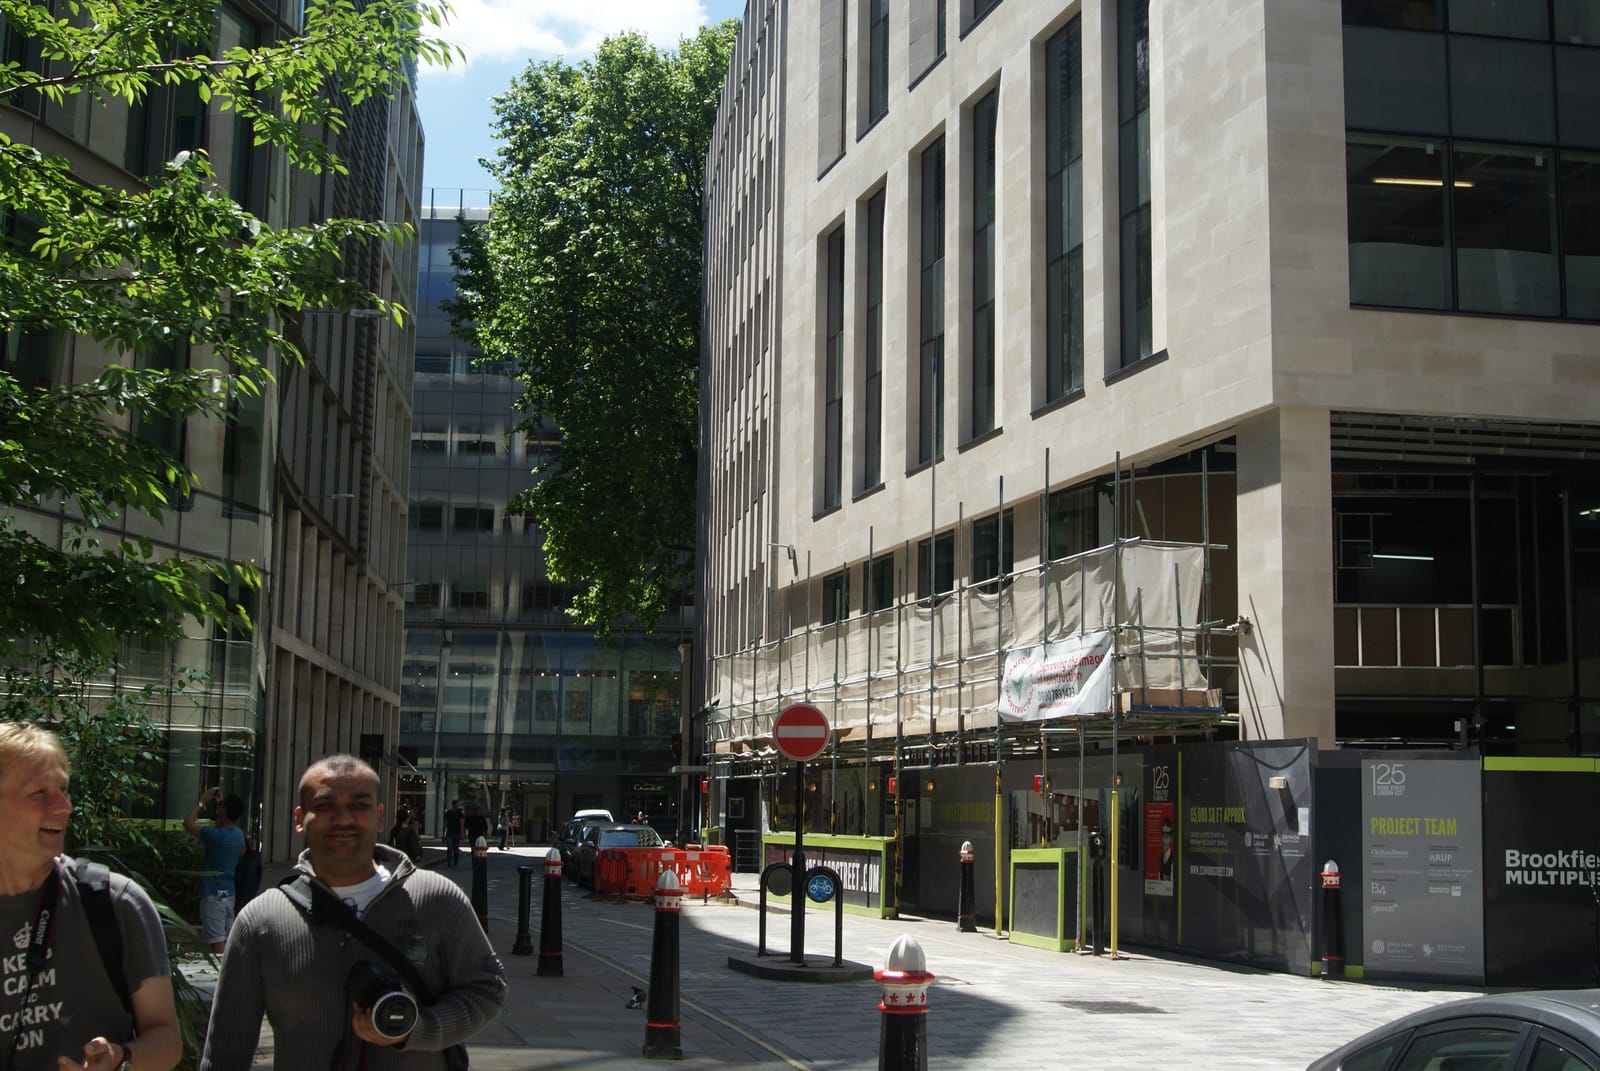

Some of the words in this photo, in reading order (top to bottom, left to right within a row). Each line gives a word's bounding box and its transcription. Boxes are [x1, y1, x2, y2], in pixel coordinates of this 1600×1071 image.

[1044, 671, 1083, 685] construction
[1152, 766, 1170, 801] 125
[1369, 763, 1406, 796] 125
[1208, 807, 1216, 824] SQ
[1216, 807, 1223, 823] FT
[1371, 817, 1421, 836] PROJECT
[1423, 817, 1457, 836] TEAM
[1429, 854, 1453, 862] ARUP
[1371, 882, 1386, 895] B4
[35, 910, 50, 945] Canon
